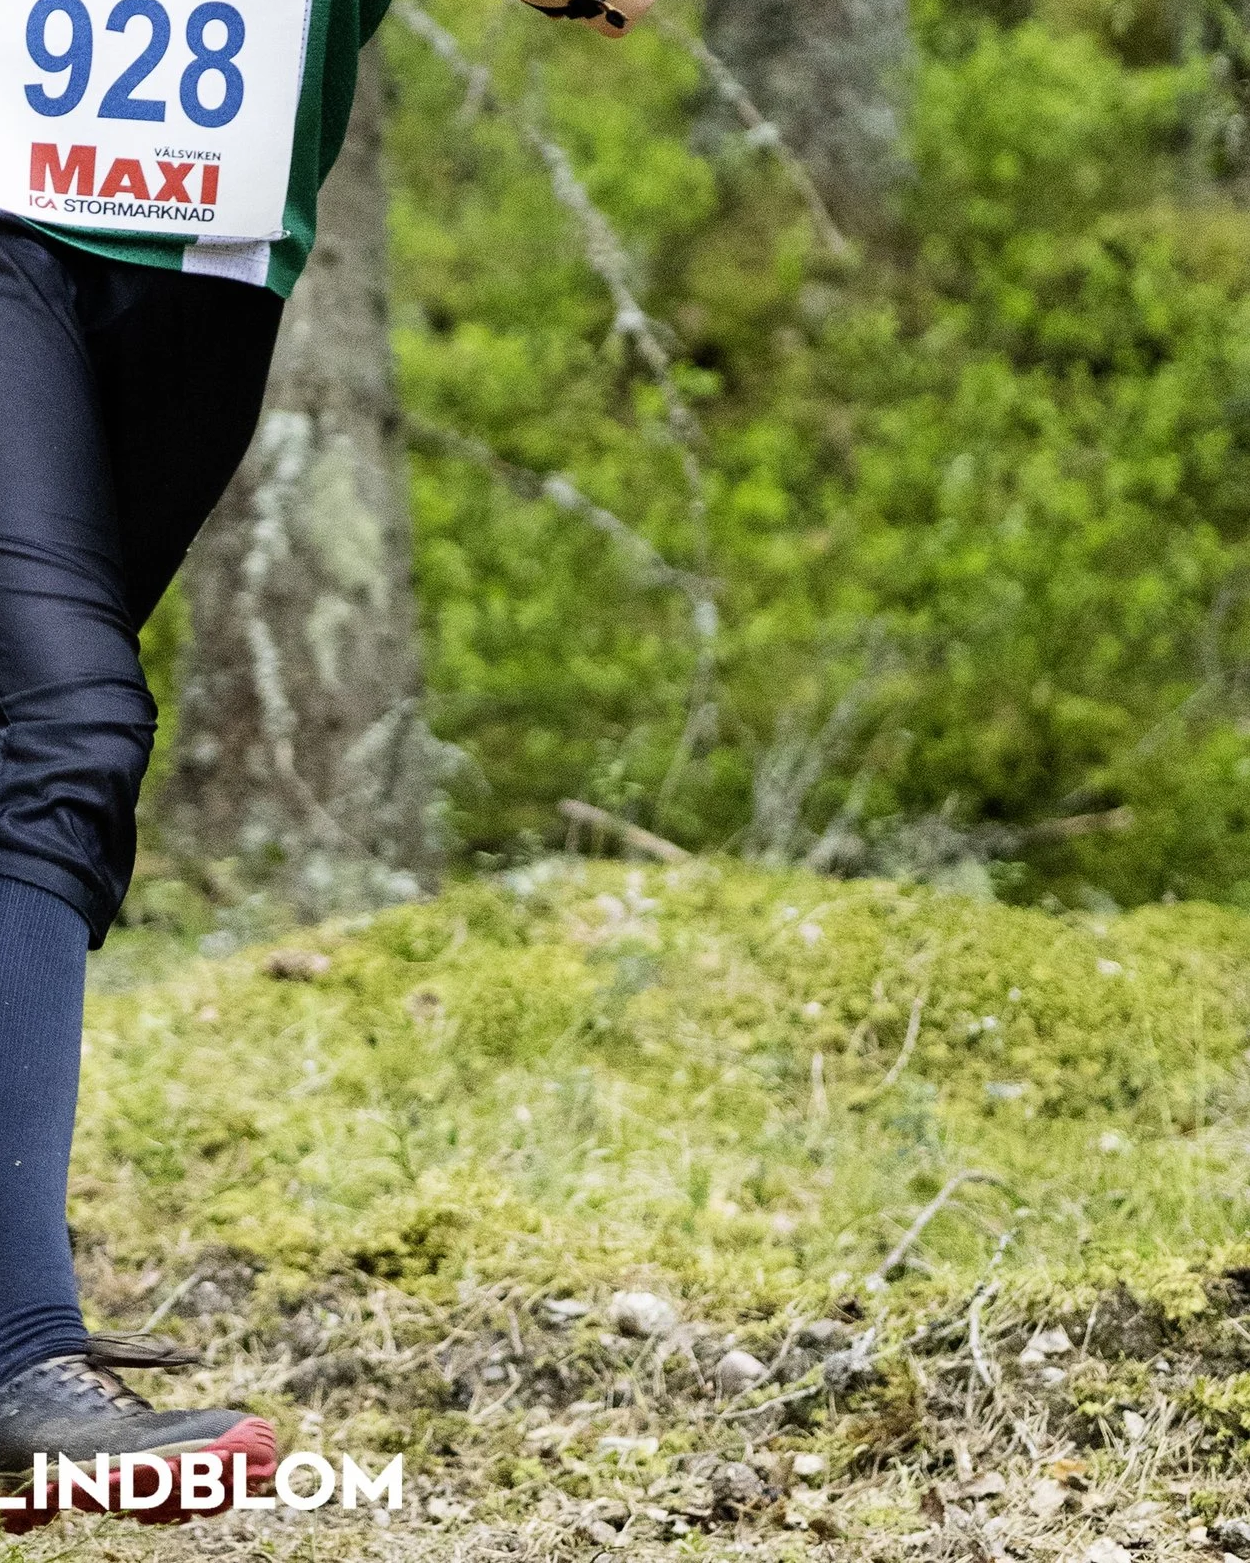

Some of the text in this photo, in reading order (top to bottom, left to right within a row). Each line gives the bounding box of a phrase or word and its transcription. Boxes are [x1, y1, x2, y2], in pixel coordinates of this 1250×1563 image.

[154, 147, 222, 162] VÄLSVIKEN
[29, 142, 220, 205] MAXI
[29, 194, 215, 223] ICA STORMARKNAD
